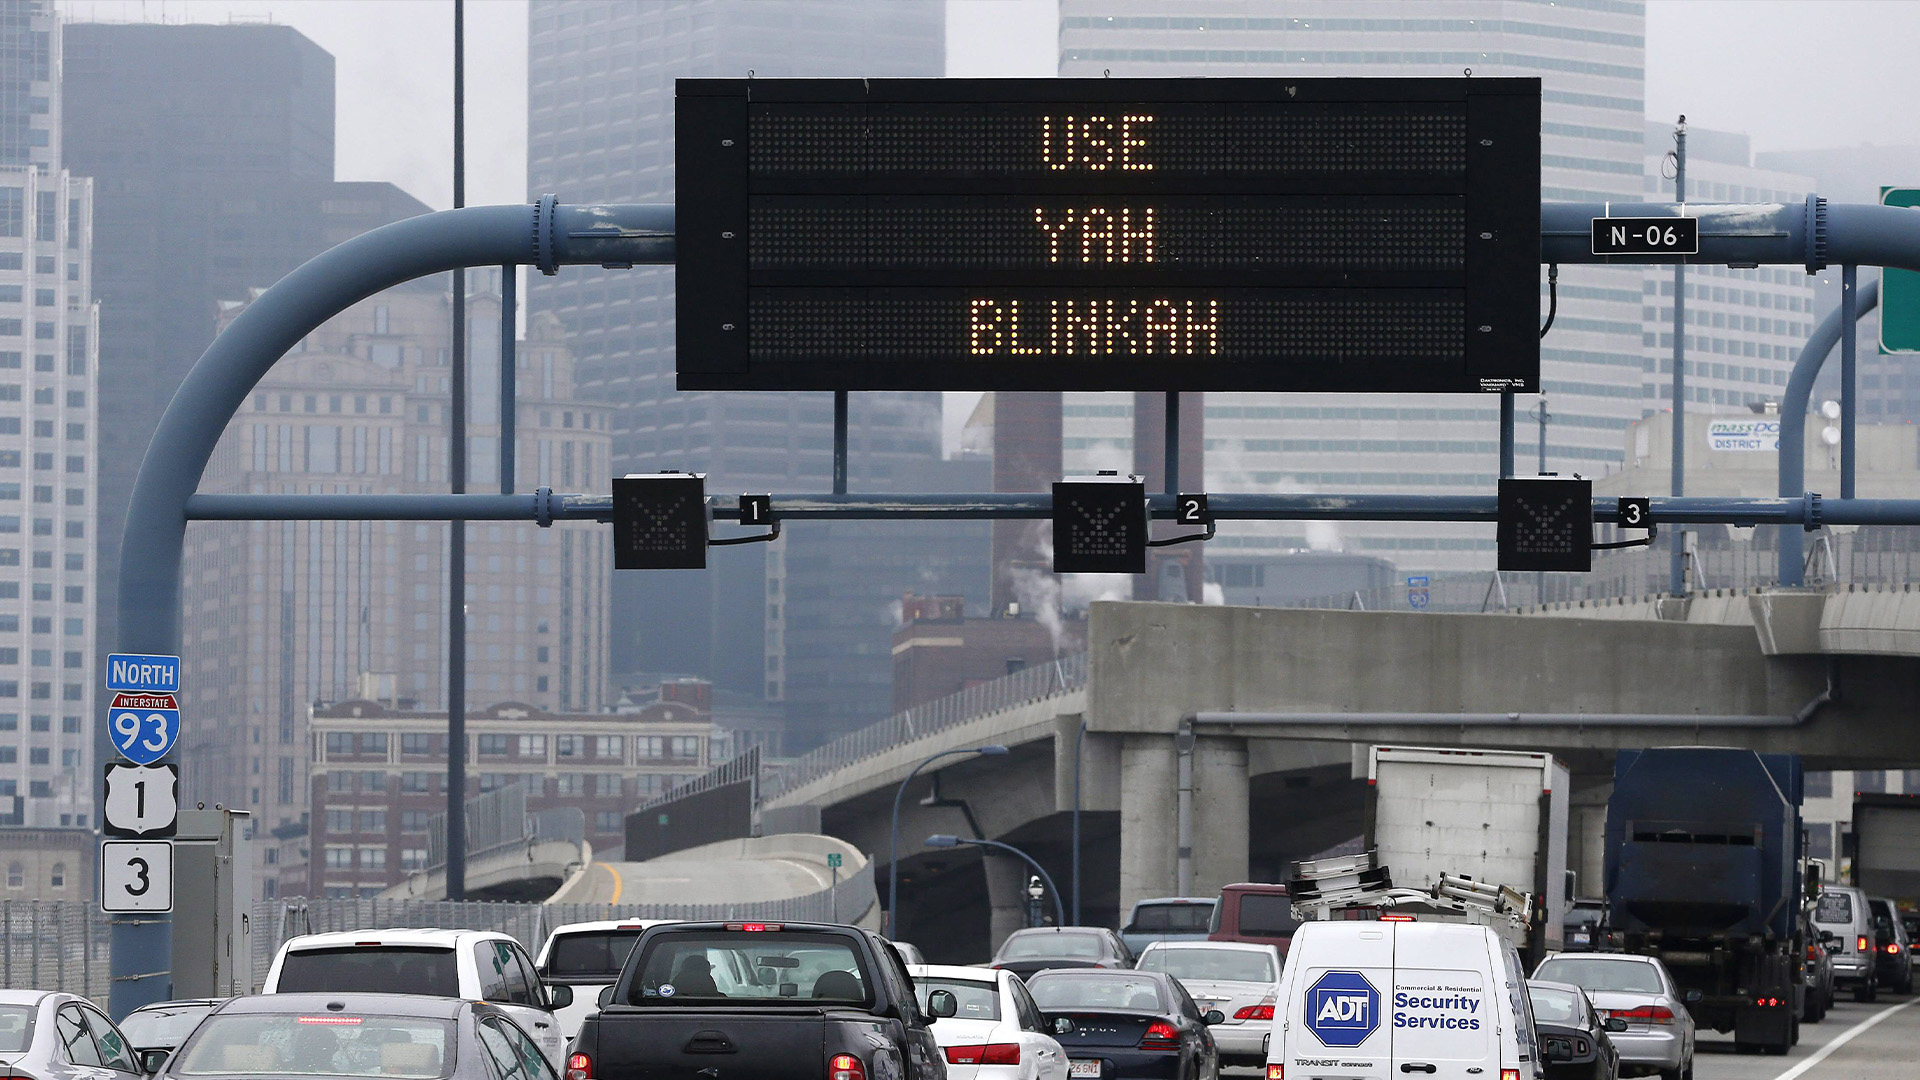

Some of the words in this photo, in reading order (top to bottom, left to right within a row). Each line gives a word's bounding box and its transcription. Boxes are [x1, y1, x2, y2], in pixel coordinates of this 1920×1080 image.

[1043, 115, 1155, 171] USE
[1035, 207, 1155, 263] YAH
[970, 299, 1219, 356] BLINKAH
[1711, 423, 1780, 432] massDO
[1715, 440, 1761, 448] DISTRICT
[751, 501, 759, 519] 1
[1186, 501, 1199, 519] 2
[1627, 504, 1641, 524] 3
[113, 660, 174, 685] NORTH
[120, 698, 169, 708] INTERSTATE
[115, 713, 168, 752] 93
[134, 781, 146, 819] 1
[124, 857, 150, 897] 3
[1317, 996, 1366, 1021] ADT
[1395, 992, 1480, 1014] Security
[1394, 1012, 1480, 1030] Services
[1070, 1063, 1081, 1073] 26
